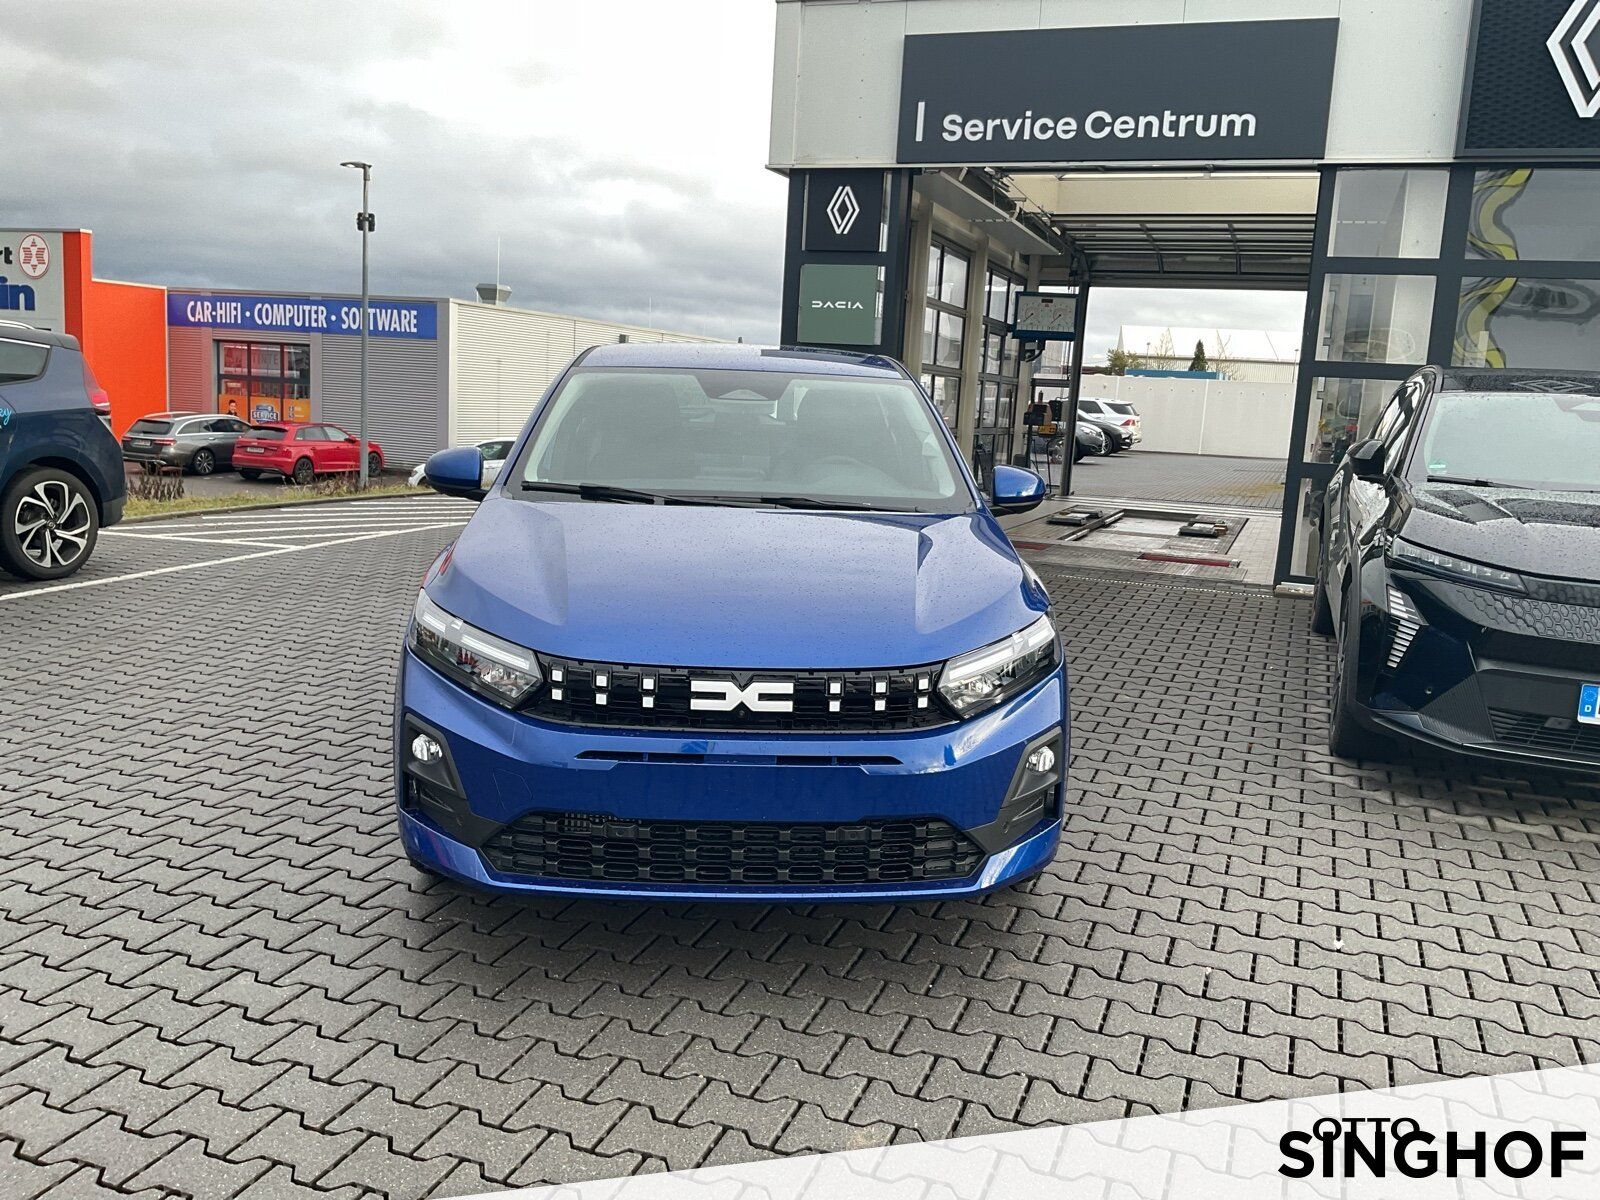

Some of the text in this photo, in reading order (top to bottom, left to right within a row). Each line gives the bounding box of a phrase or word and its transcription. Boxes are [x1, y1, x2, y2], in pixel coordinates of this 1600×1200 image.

[942, 110, 1257, 142] Service Centrum
[186, 301, 242, 324] CAR-HIFI
[253, 303, 327, 328] COMPUTER
[811, 300, 864, 309] DACIA
